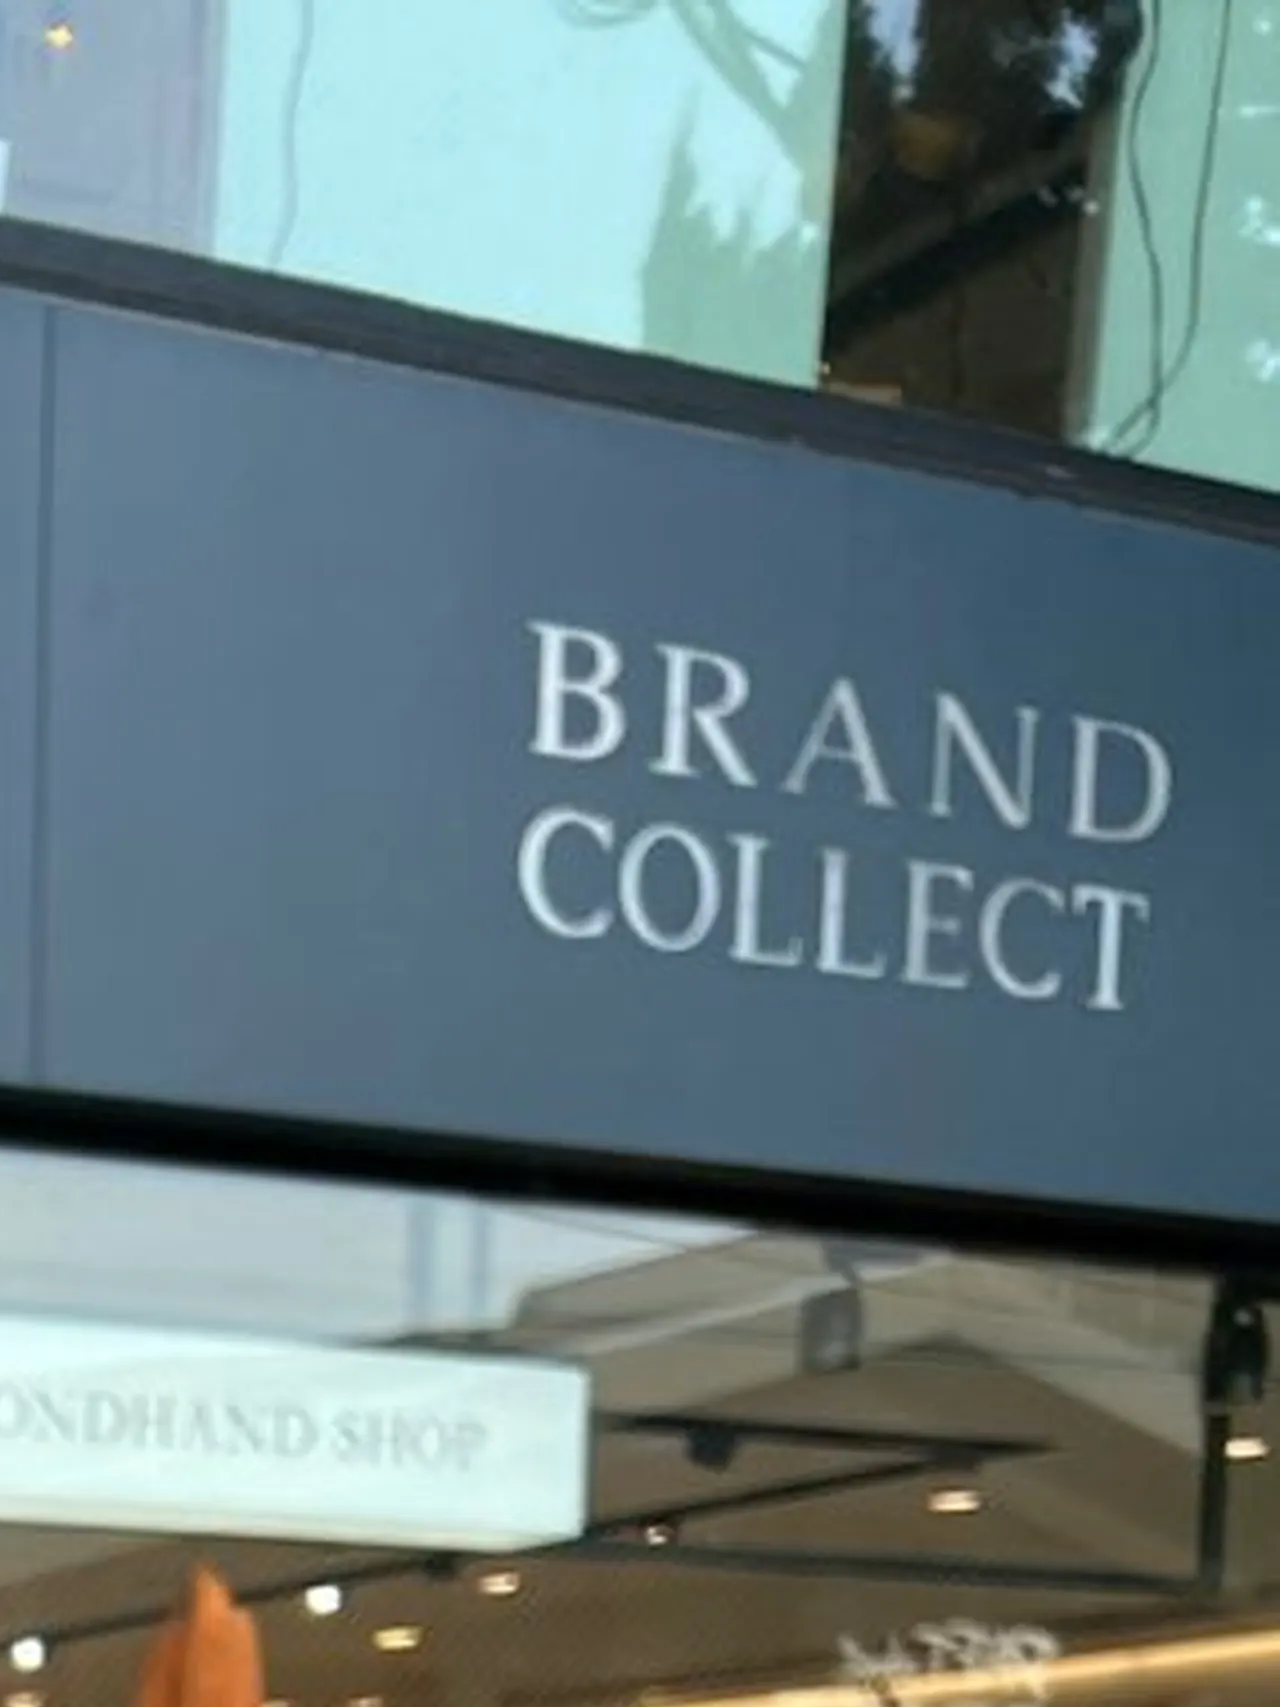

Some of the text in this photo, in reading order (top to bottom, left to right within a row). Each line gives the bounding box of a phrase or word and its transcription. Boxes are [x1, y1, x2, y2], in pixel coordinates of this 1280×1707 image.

[526, 618, 1172, 844] BRAND
[517, 804, 1150, 1010] COLLECT
[328, 1402, 489, 1472] SHOP
